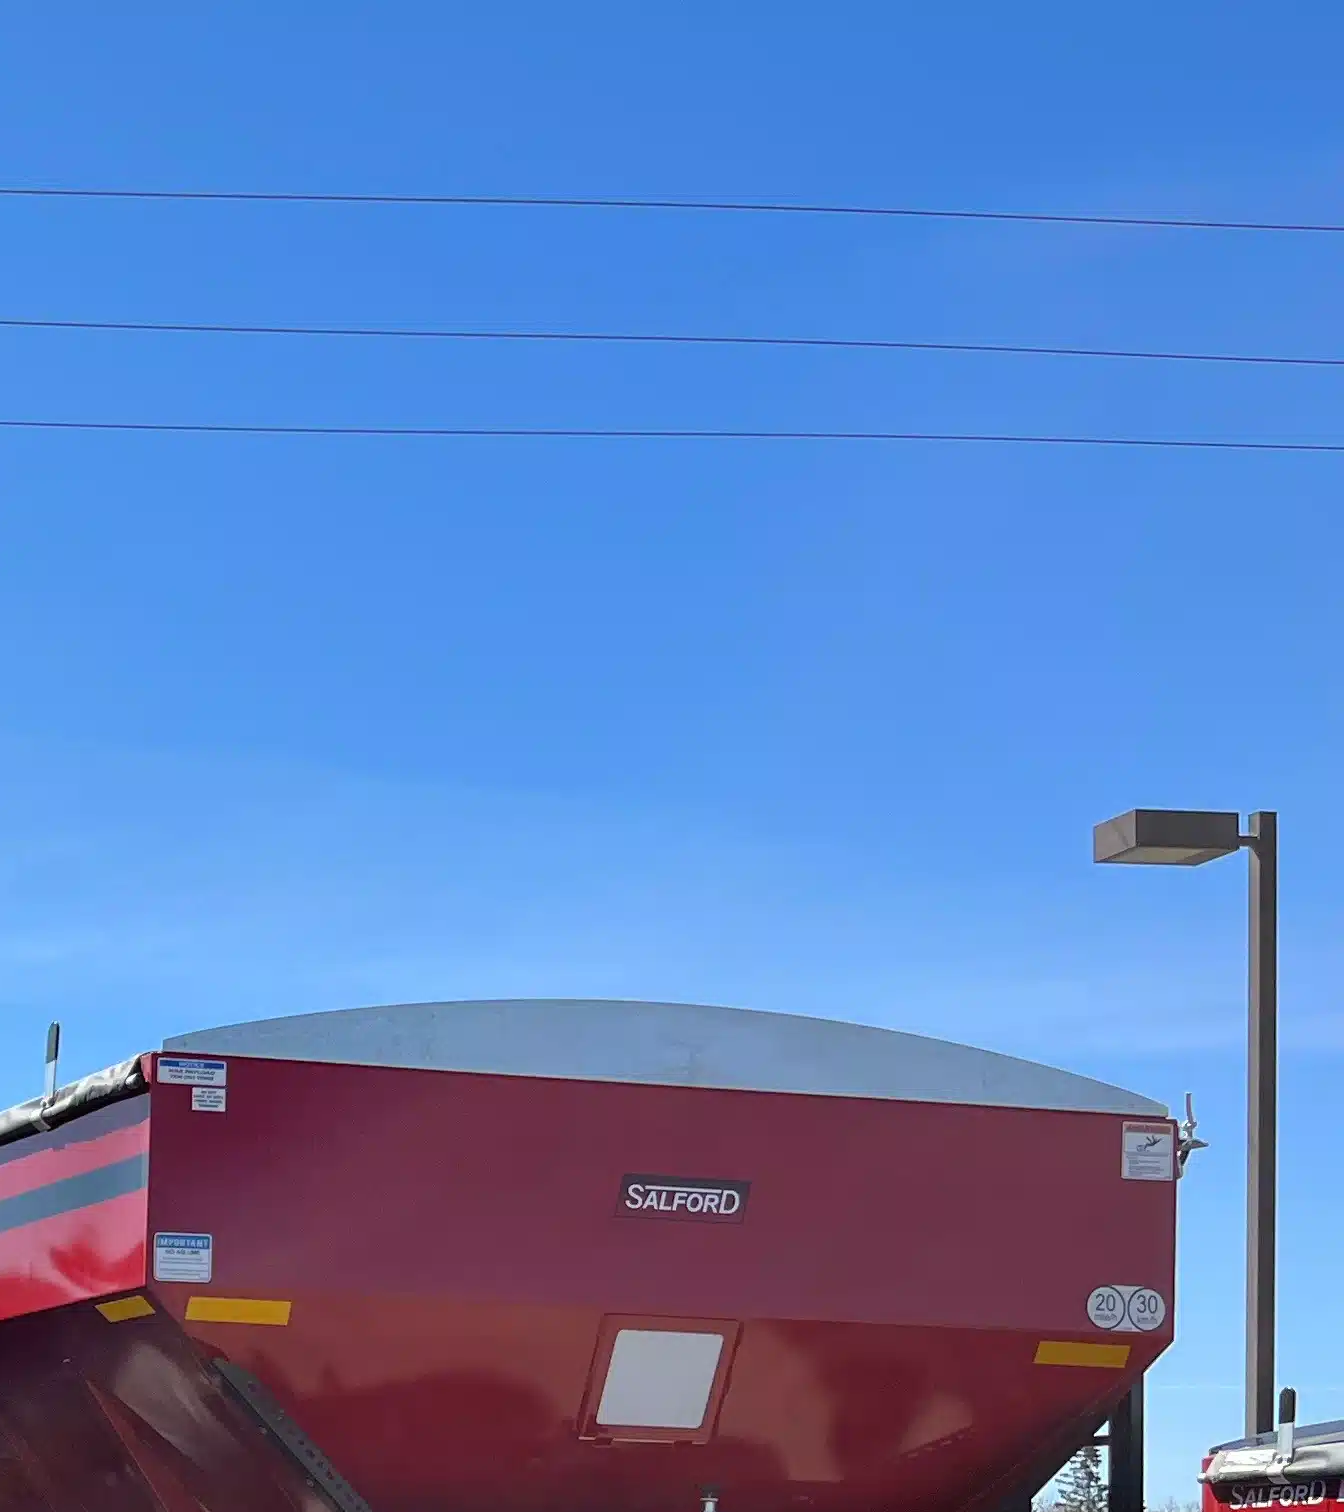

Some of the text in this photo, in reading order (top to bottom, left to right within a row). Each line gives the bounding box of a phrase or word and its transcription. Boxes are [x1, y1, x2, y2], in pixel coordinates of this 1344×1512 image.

[625, 1184, 740, 1215] SALFORD
[157, 1237, 209, 1249] IMPORTANT
[1095, 1293, 1116, 1312] 20
[1136, 1294, 1158, 1314] 30
[1230, 1480, 1326, 1510] SALFORD
